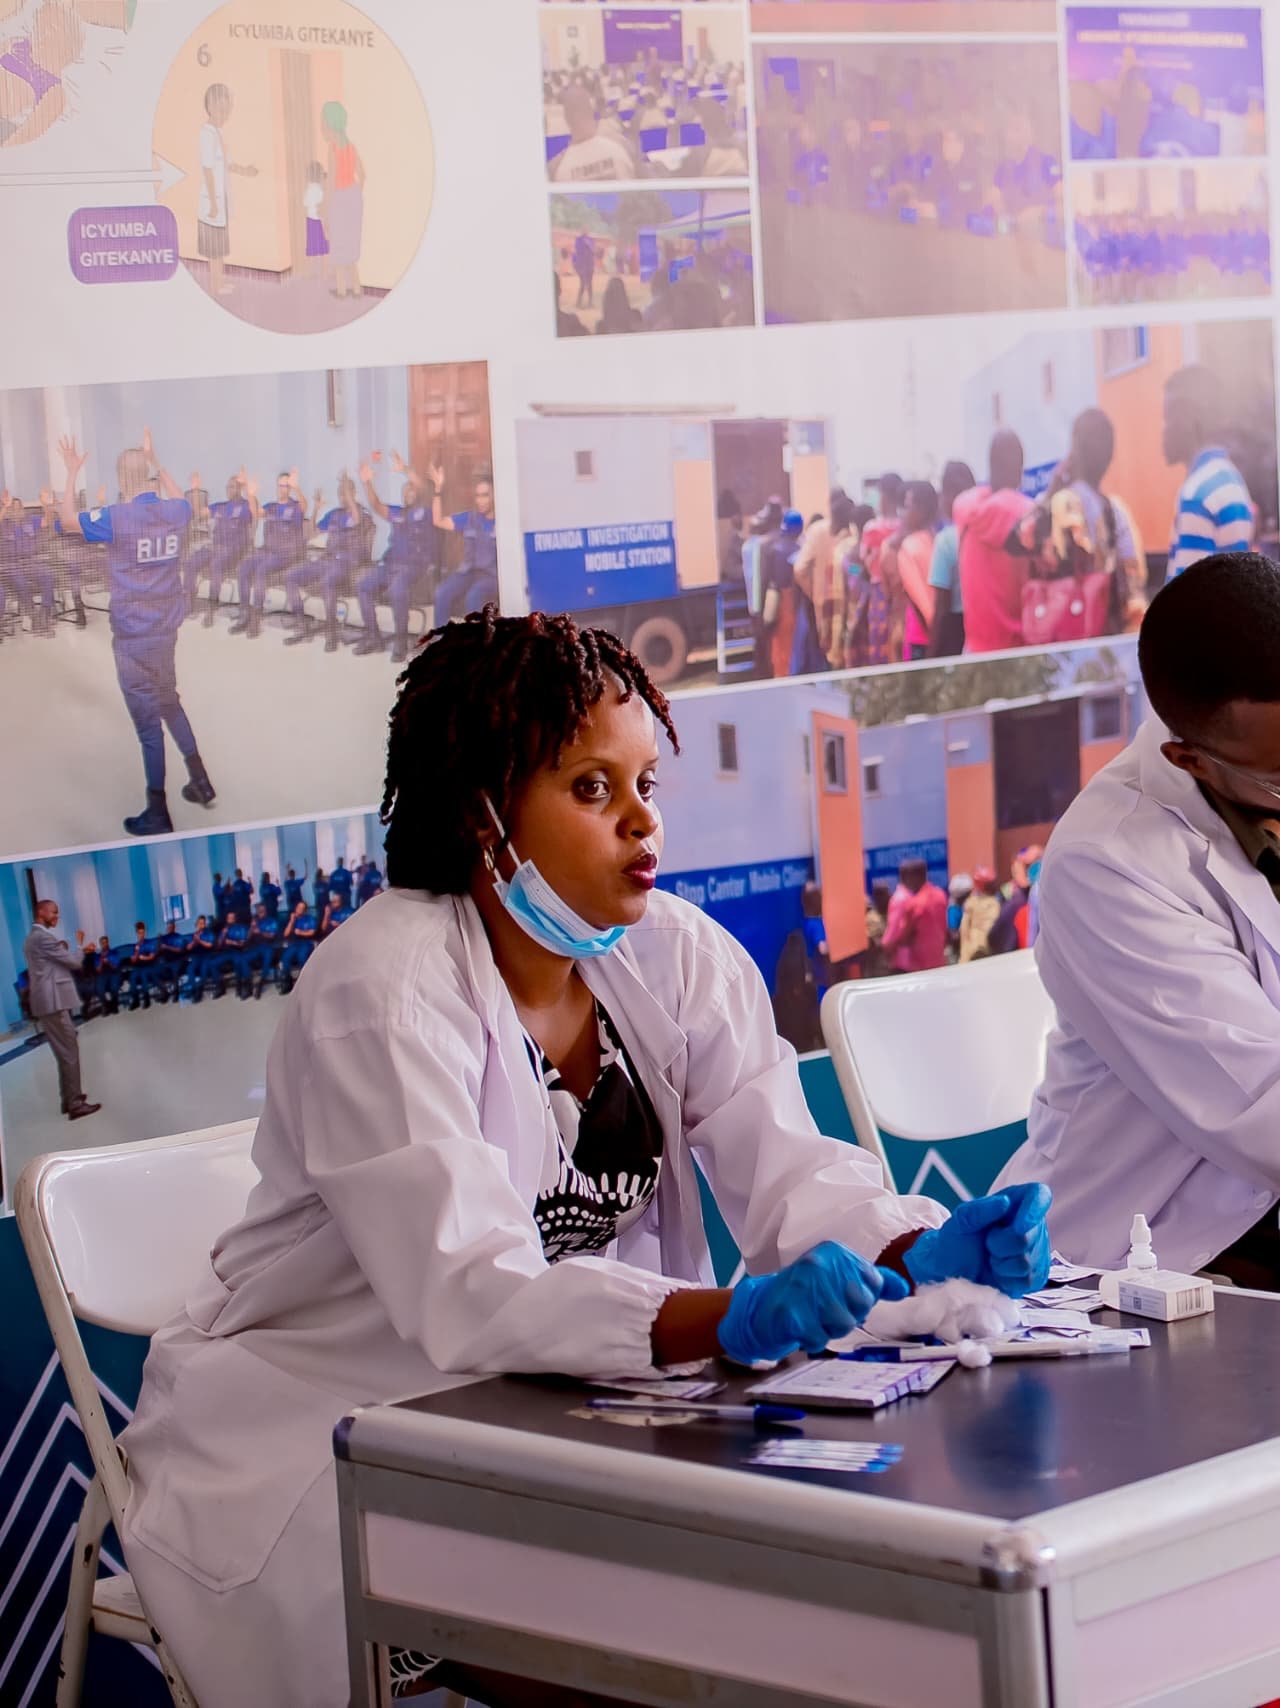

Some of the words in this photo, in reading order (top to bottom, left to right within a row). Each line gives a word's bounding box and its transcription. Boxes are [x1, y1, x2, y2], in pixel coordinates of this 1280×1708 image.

[229, 23, 294, 41] ICYUMBA
[298, 27, 374, 48] GITEKANYE
[197, 43, 212, 67] 6
[81, 222, 157, 238] ICYUMBA
[80, 249, 174, 267] GITEKANYE
[534, 530, 583, 552] RWANDA
[587, 523, 669, 547] INVESTIGATION
[585, 550, 627, 572] MOBILE
[627, 546, 671, 568] STATION
